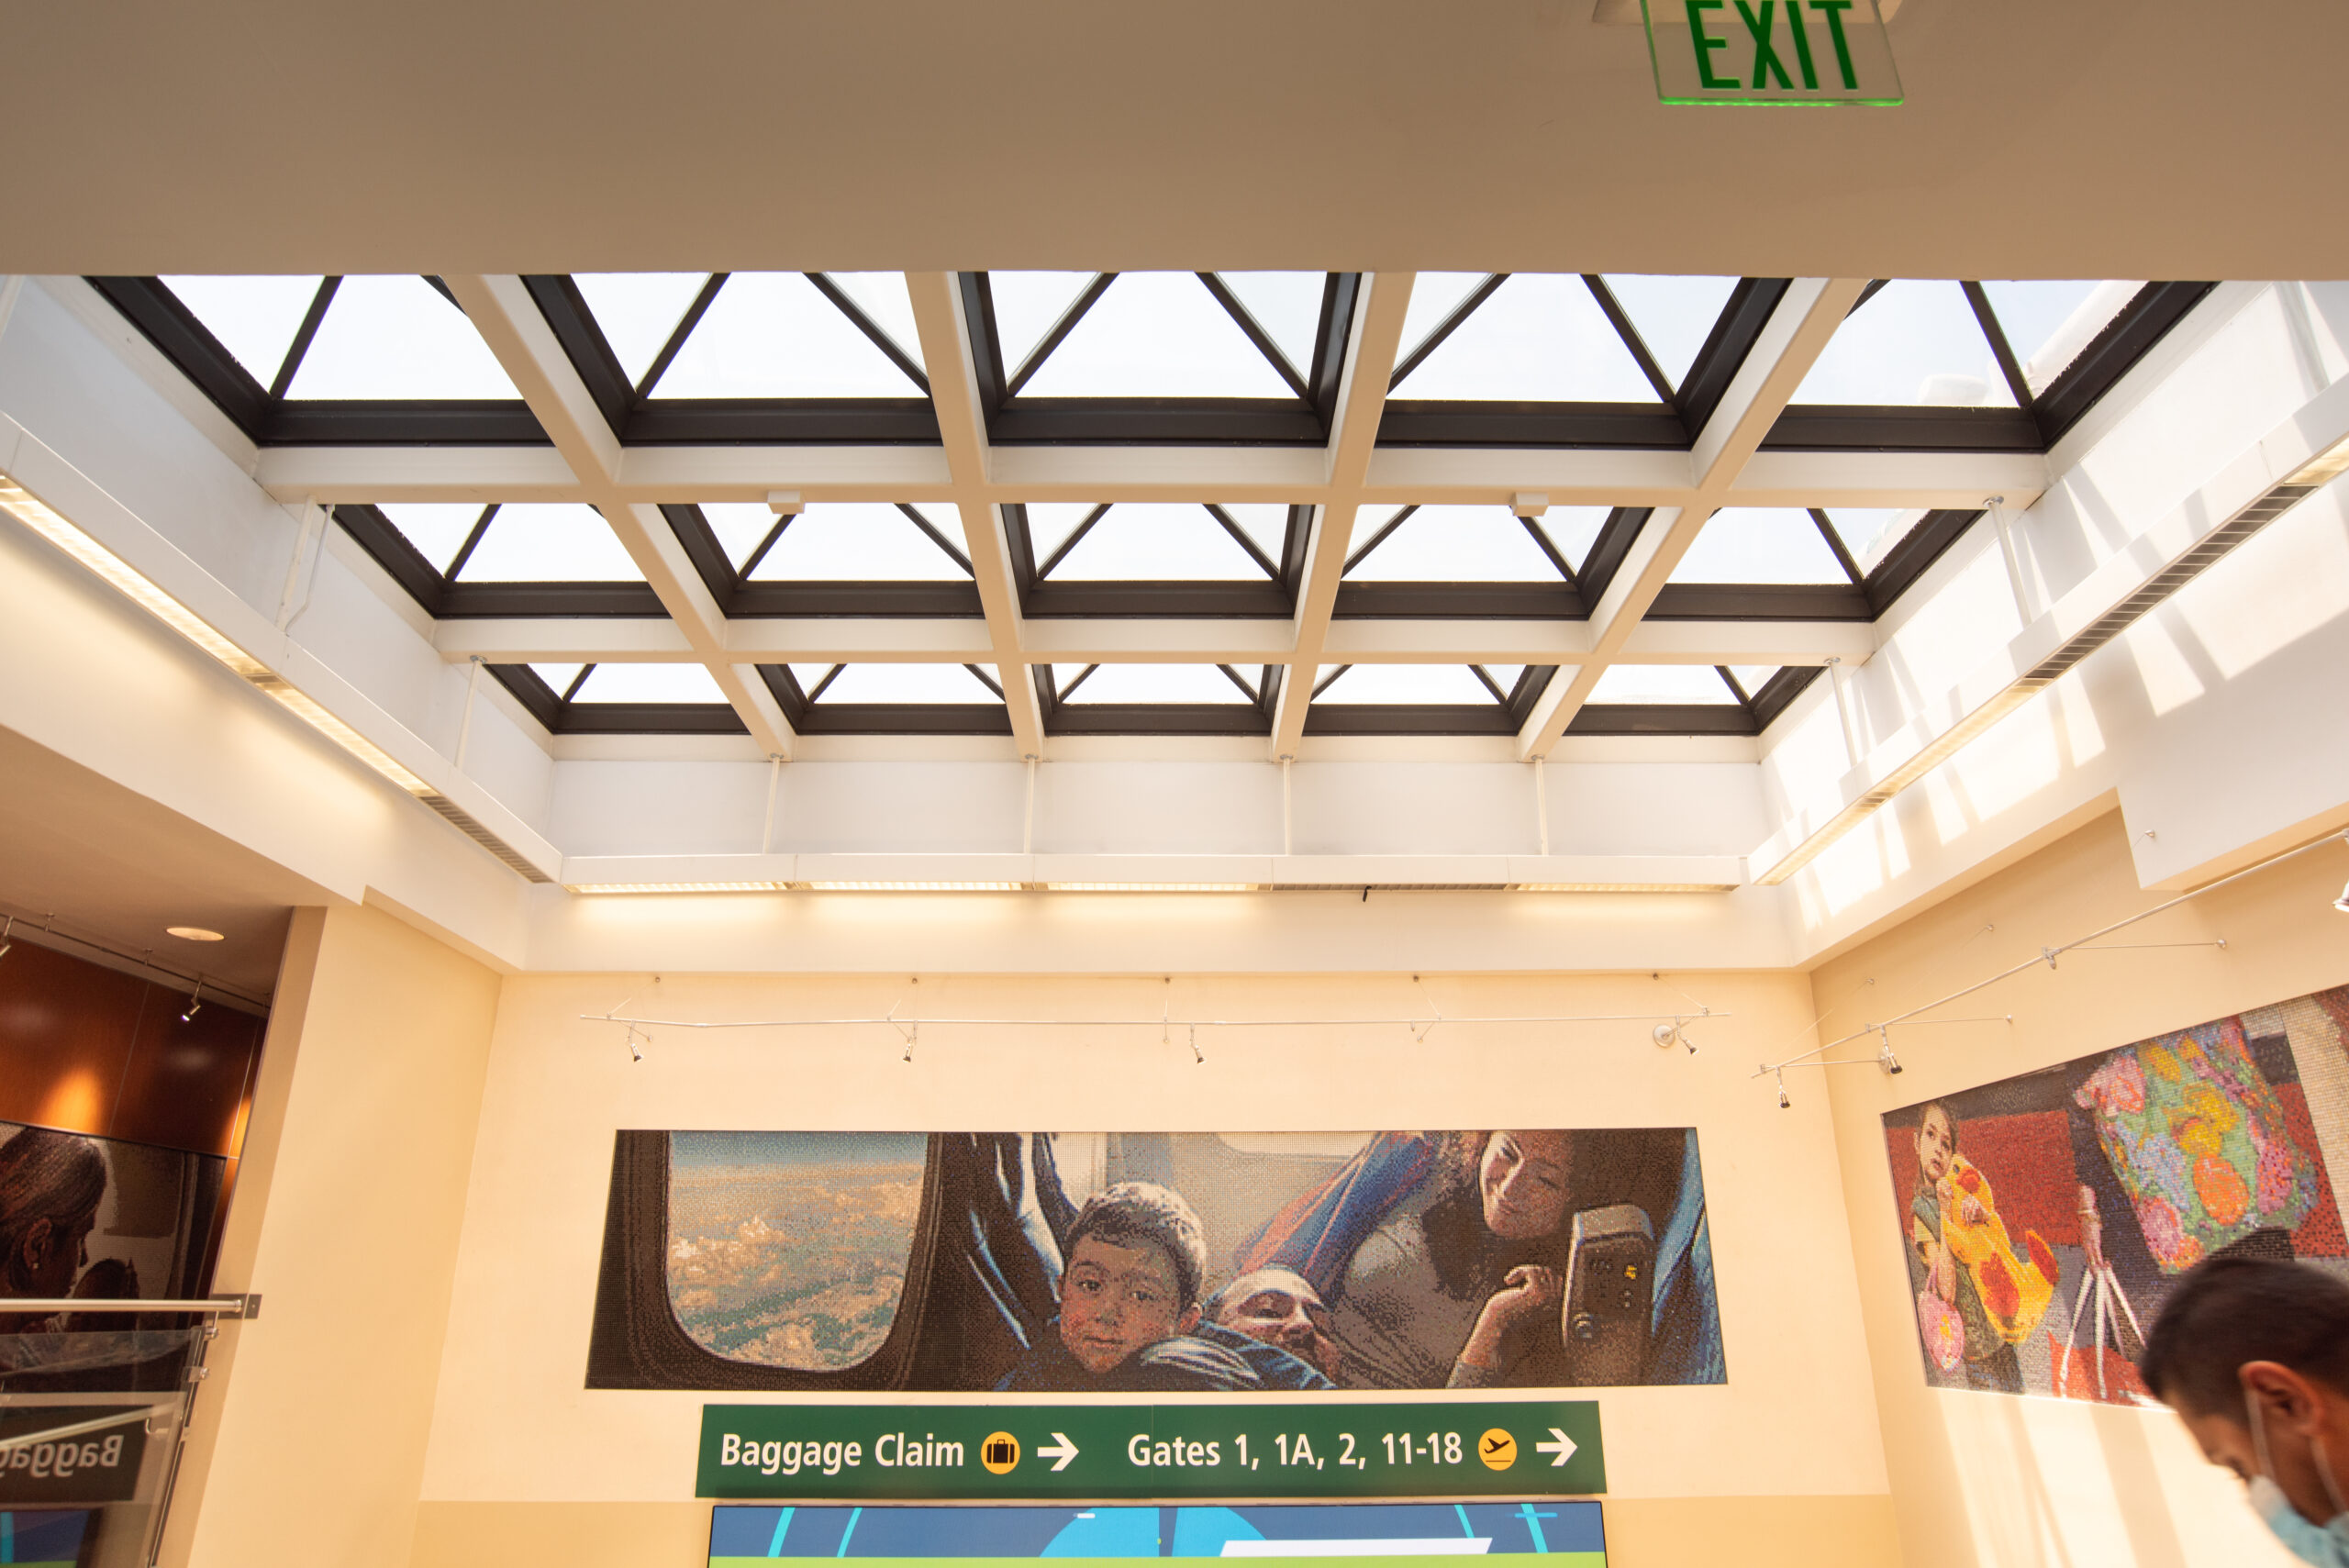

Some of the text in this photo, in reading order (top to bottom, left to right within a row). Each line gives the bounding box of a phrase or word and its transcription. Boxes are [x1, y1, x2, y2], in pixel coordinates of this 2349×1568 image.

[1686, 0, 1858, 90] EXIT
[720, 1432, 964, 1475] Baggage Claim
[1128, 1431, 1464, 1471] Gates 1, 1A, 2, 11-18
